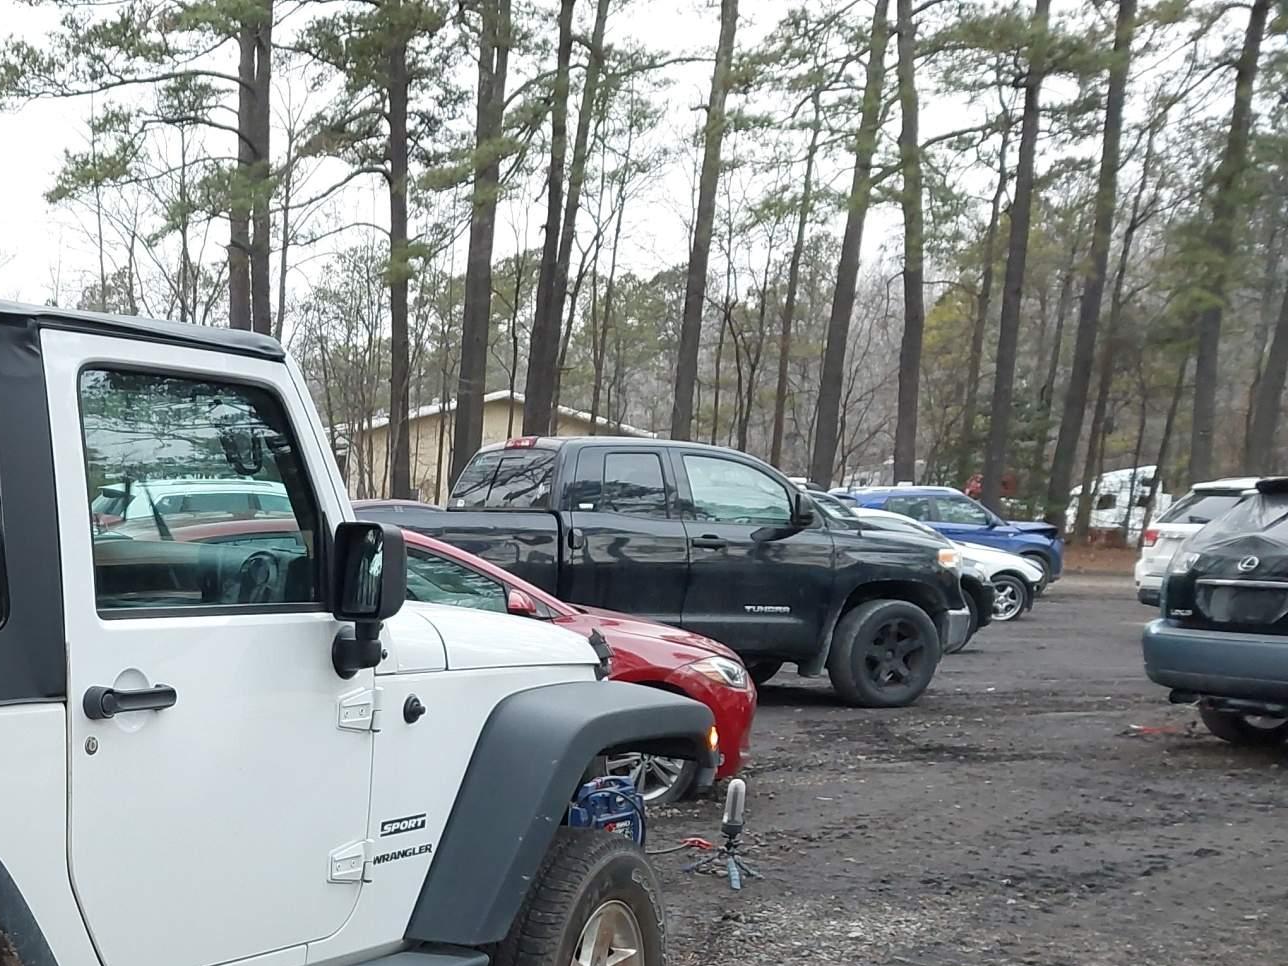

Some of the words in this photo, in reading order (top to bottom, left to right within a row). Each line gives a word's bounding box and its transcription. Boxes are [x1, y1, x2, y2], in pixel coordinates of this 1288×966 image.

[744, 605, 791, 613] TUNDRA
[382, 818, 424, 834] SPORT
[372, 843, 433, 865] WRANGLER
